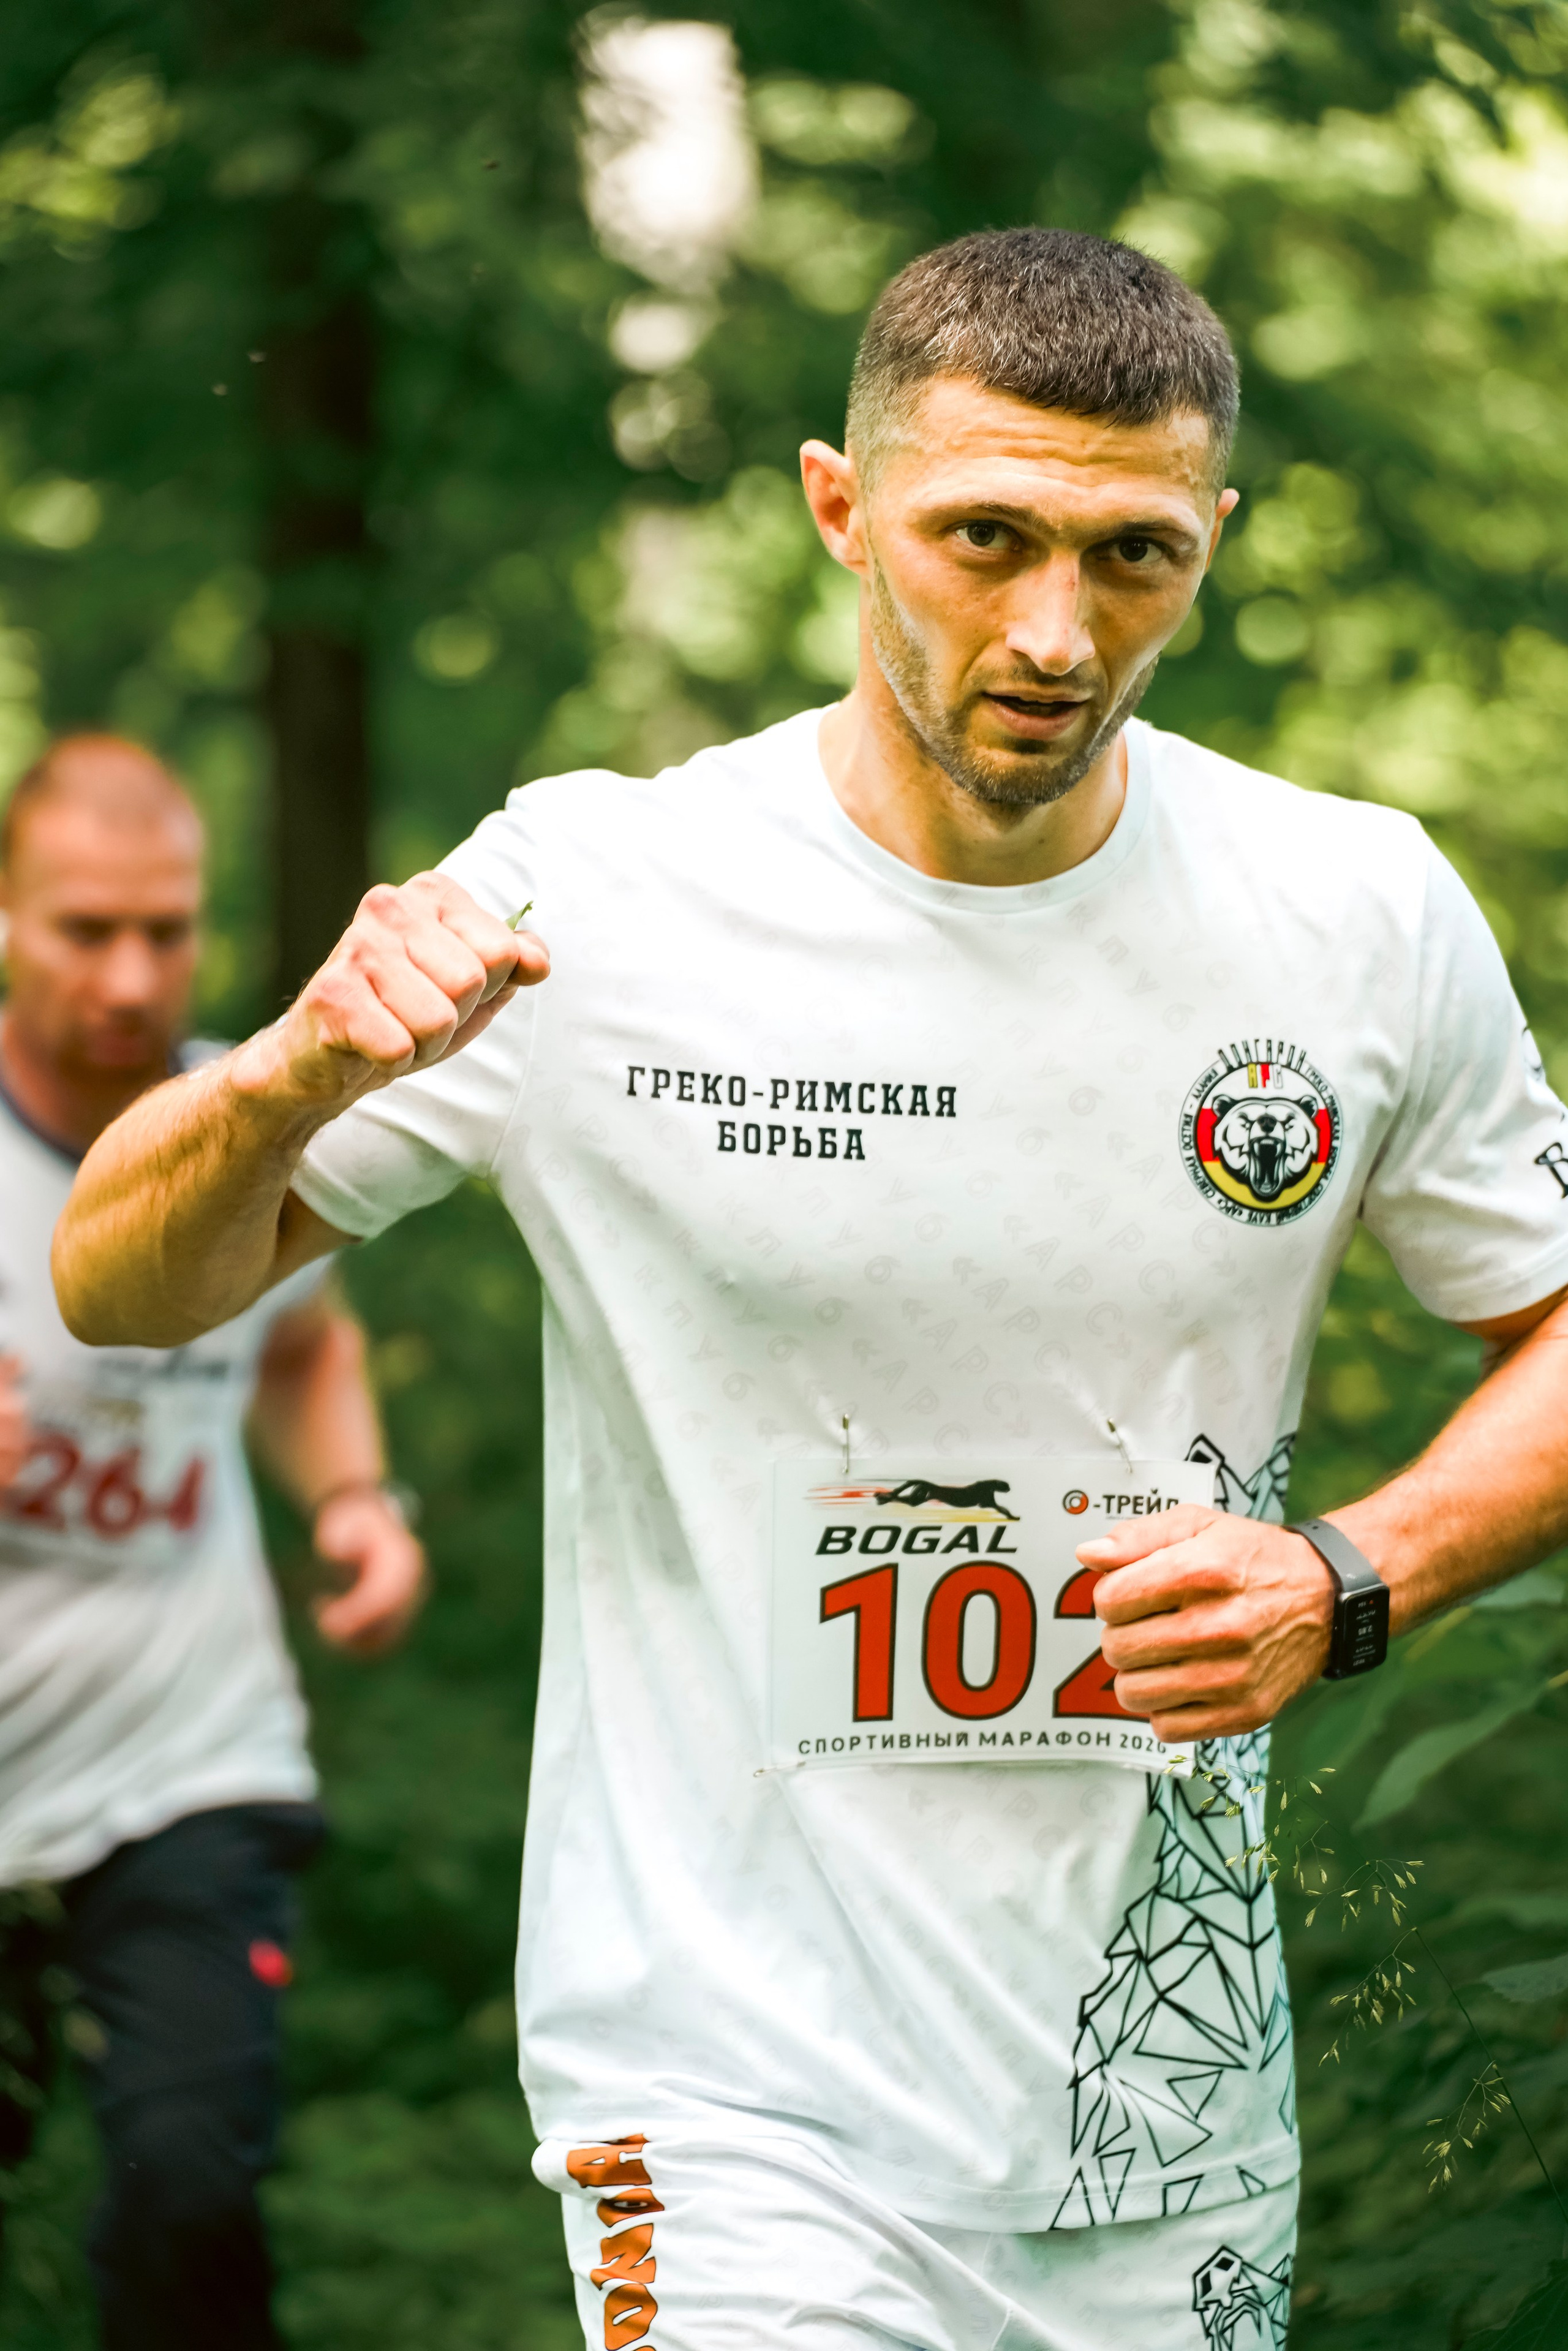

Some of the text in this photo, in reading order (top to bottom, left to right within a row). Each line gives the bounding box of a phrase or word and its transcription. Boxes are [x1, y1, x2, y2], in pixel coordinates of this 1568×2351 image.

[627, 1066, 957, 1117] ГРЕКО-РИМСКАЯ
[718, 1120, 865, 1160] БОРЬБА
[815, 1525, 1017, 1555] BOGAL
[799, 1732, 969, 1754] СПОРТИВНЫЙ
[980, 1730, 1110, 1746] МАРАФОН
